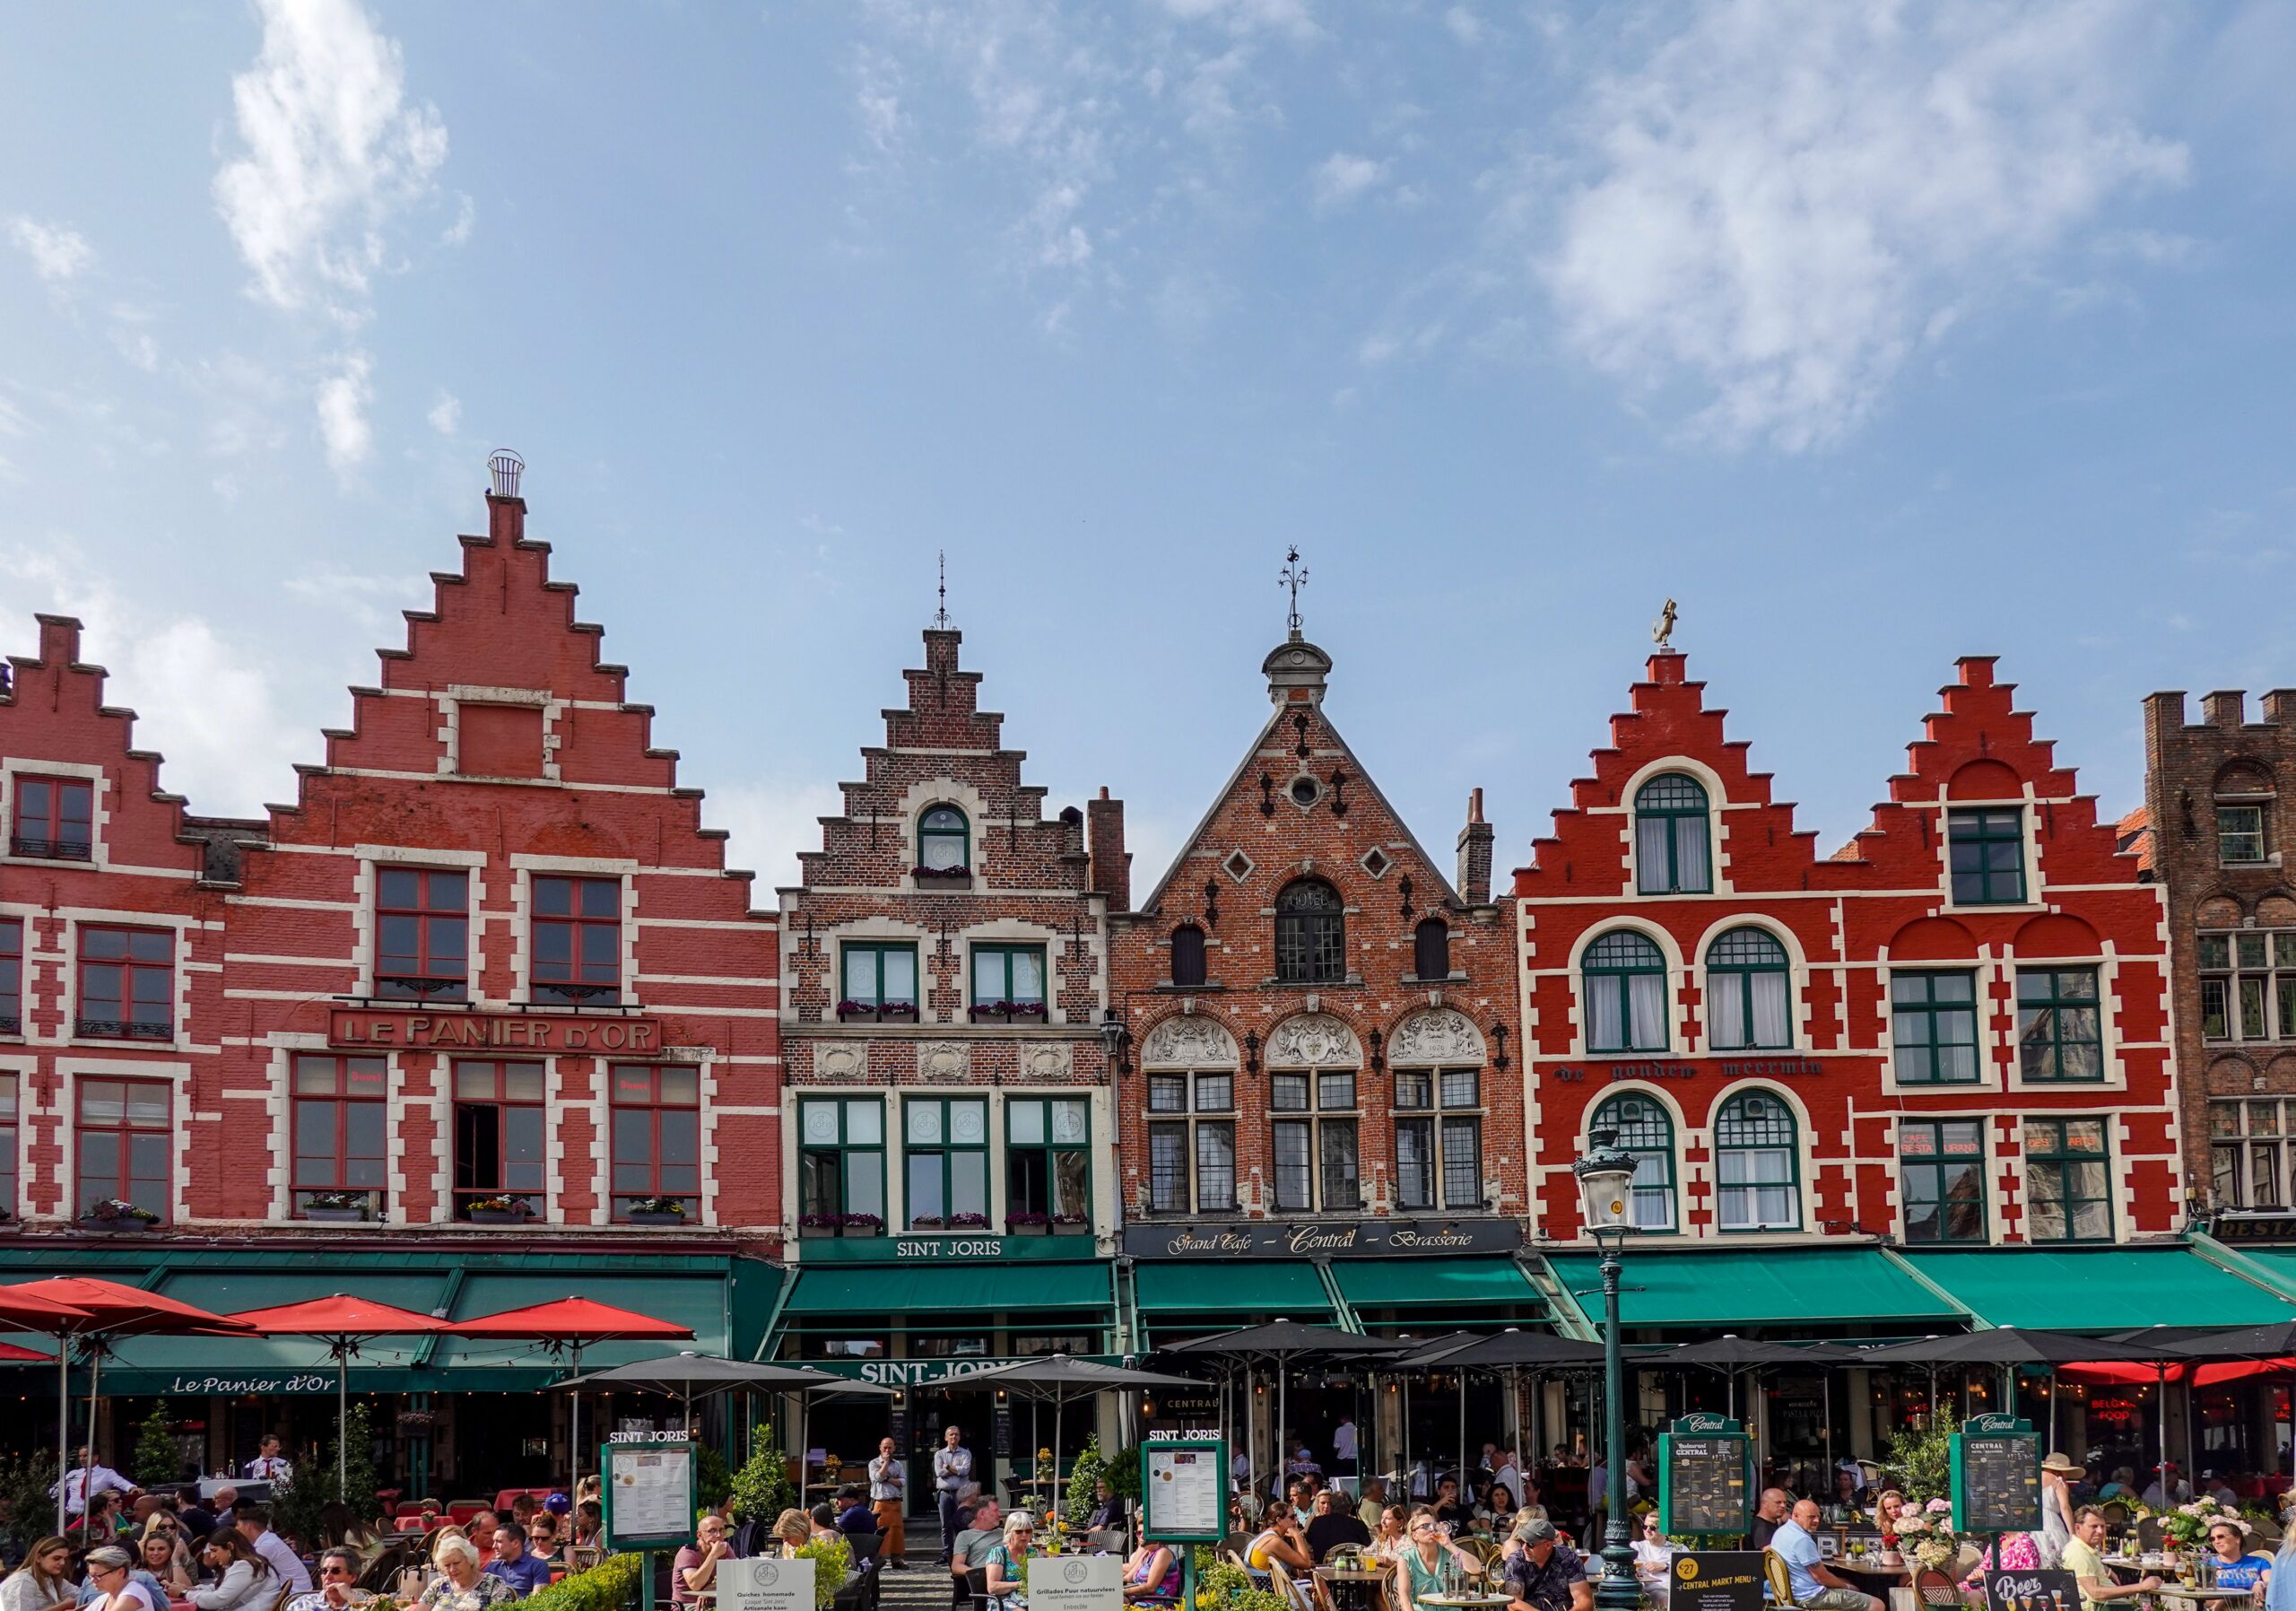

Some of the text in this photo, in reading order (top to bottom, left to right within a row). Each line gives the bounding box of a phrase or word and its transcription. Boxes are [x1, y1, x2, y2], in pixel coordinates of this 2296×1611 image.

[344, 1015, 652, 1050] LE PANIER D'OR
[1559, 1058, 1822, 1082] de gouden meermin
[1168, 1234, 1219, 1255] Grand
[1220, 1233, 1252, 1255] Cafe
[1288, 1225, 1357, 1253] Central
[1389, 1231, 1474, 1247] Brasserie
[897, 1241, 1002, 1257] SINT JORIS
[860, 1361, 1023, 1384] SINT-JO
[172, 1375, 335, 1392] Le Panier d'Or
[1168, 1399, 1219, 1407] CENTRAL
[1809, 1409, 1825, 1418] PIZZ
[2100, 1410, 2130, 1420] FOOD
[1690, 1415, 1725, 1432] Central
[1980, 1415, 2016, 1432] Central
[610, 1431, 689, 1443] SINT JORIS
[1149, 1429, 1220, 1441] SINT JORIS
[757, 1571, 776, 1579] Joris
[1679, 1563, 1694, 1574] €27
[1683, 1575, 1752, 1590] CENTRAL MARKT MENU
[1995, 1575, 2042, 1600] Beer
